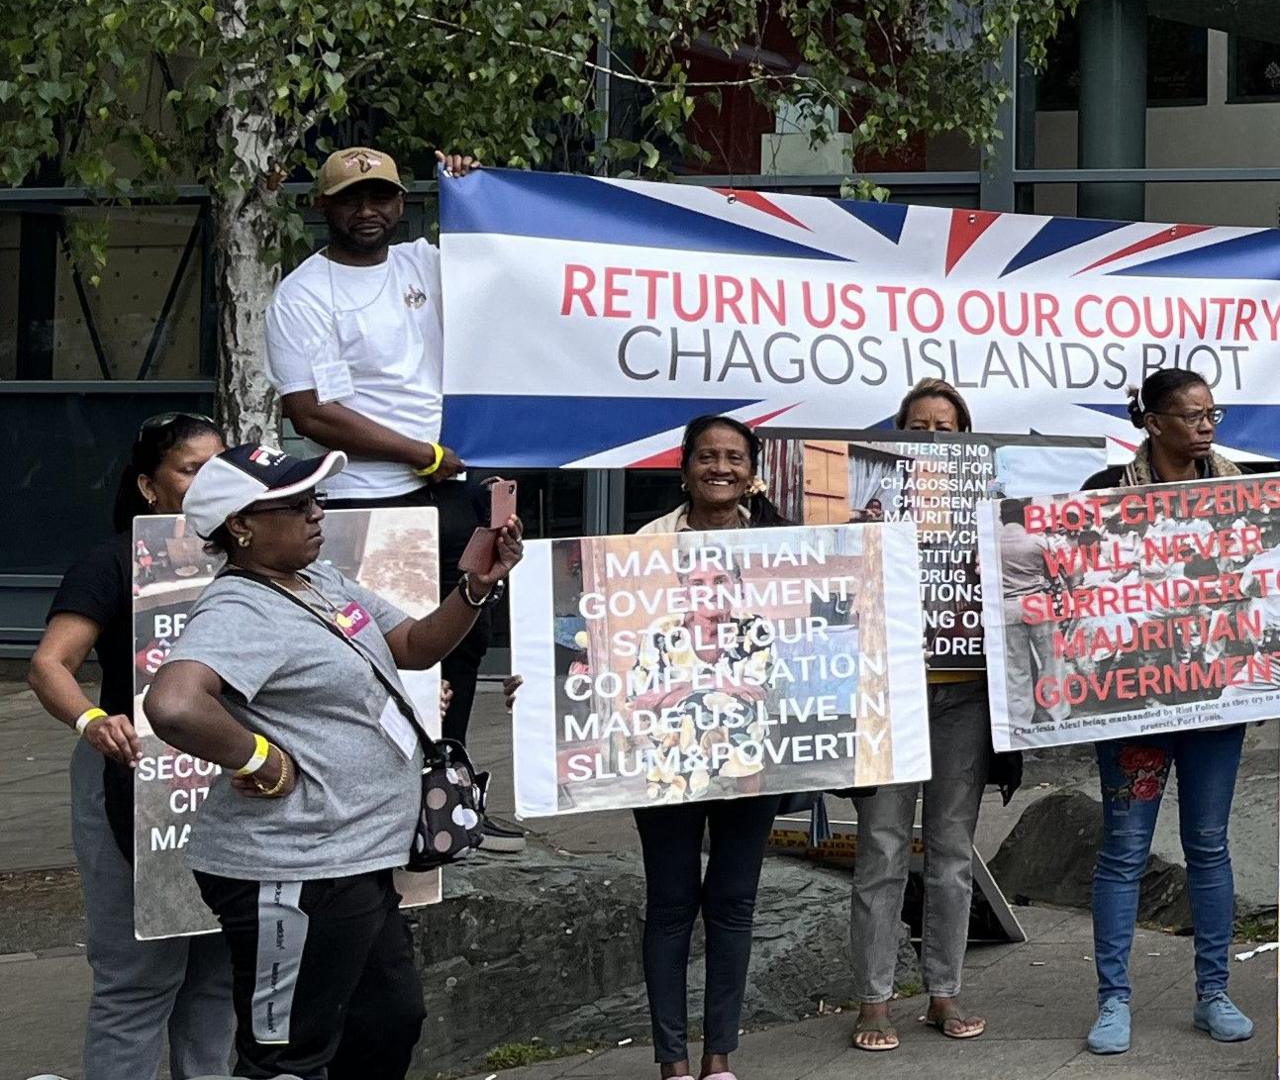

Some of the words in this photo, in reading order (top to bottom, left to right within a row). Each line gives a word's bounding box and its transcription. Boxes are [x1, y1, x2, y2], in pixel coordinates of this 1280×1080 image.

[561, 263, 786, 326] RETURN
[802, 282, 865, 330] US
[880, 286, 944, 334] TO
[957, 289, 1060, 338] OUR
[617, 325, 888, 386] CHAGOS
[907, 338, 1126, 389] ISLANDS
[1141, 343, 1249, 390] BIOT
[895, 460, 957, 473] FUTURE
[961, 461, 993, 475] FOR
[897, 443, 961, 456] THERE'S
[965, 444, 989, 457] NO
[880, 477, 987, 491] CHAGOSSIAN
[892, 496, 971, 509] CHILDREN
[1022, 498, 1107, 534] BIOT
[606, 540, 826, 578] MAURITIAN
[1042, 541, 1131, 578] WILL
[1140, 525, 1263, 565] NEVER
[578, 575, 854, 620] GOVERNMENT
[1021, 576, 1243, 626] SURRENDER
[612, 622, 748, 657] STOLE
[750, 616, 829, 649] OUR
[1052, 610, 1262, 661] MAURITIAN
[564, 650, 884, 702] COMPENSATION
[565, 707, 683, 741] MADE
[689, 701, 748, 732] US
[758, 695, 839, 726] LIVE
[849, 692, 886, 719] IN
